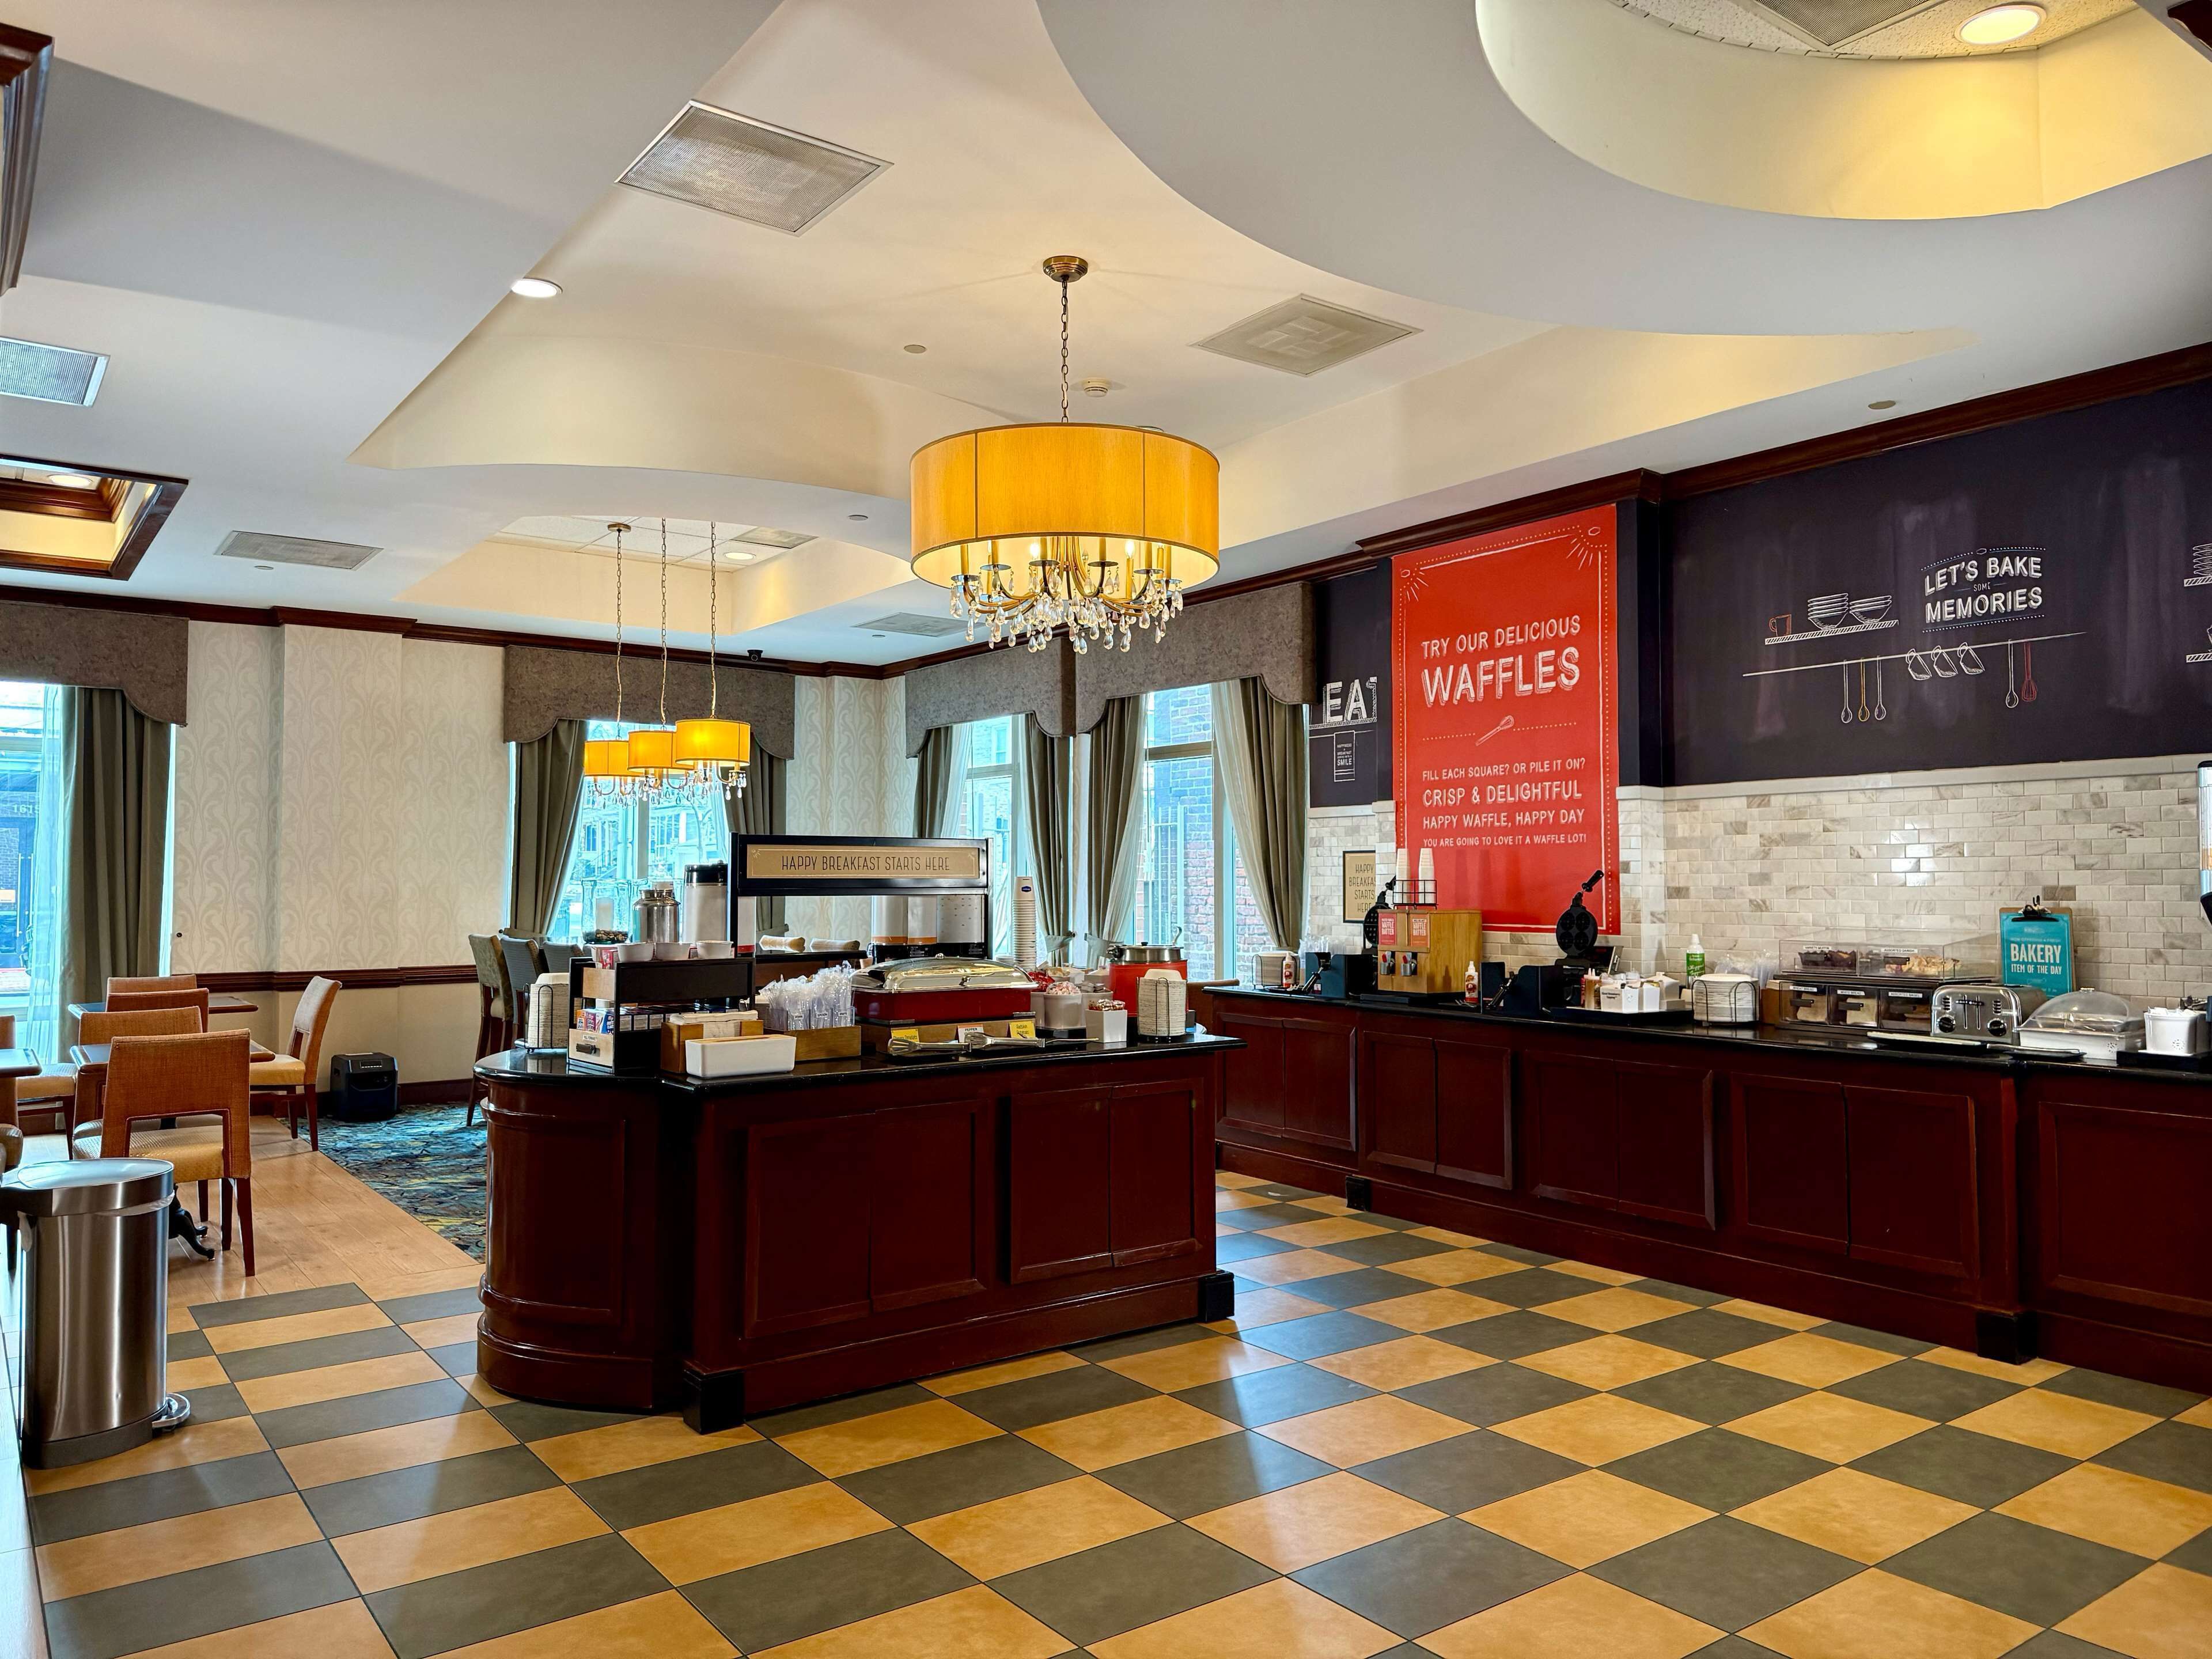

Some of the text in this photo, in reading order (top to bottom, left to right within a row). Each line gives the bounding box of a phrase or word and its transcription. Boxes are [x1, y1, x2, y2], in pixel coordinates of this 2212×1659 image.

[1925, 556, 2042, 596] LET'S BAKE
[1974, 582, 1991, 592] SOME
[1926, 586, 2042, 623] MEMORIES
[1421, 615, 1581, 659] TRY OUR DELICIOUS
[1422, 647, 1580, 707] WAFFLES
[1337, 758, 1352, 766] SMILE
[1423, 757, 1585, 781] FILL EACH SQUARE? OR PILE IT ON?
[1423, 779, 1582, 807] CRISP & DELIGHTFUL
[1423, 808, 1584, 830] HAPPY WAFFLE, HAPPY DAY
[1423, 833, 1586, 847] YOU ARE GOING TO LOVE IT A WAFFLE LOT!
[782, 856, 949, 870] HAPPY BREAKFAST STARTS HERE
[1355, 863, 1374, 873] HAPPY
[1354, 889, 1375, 900] STARTS
[2010, 943, 2062, 964] BAKERY
[2011, 964, 2062, 975] ITEM OF THE DAY
